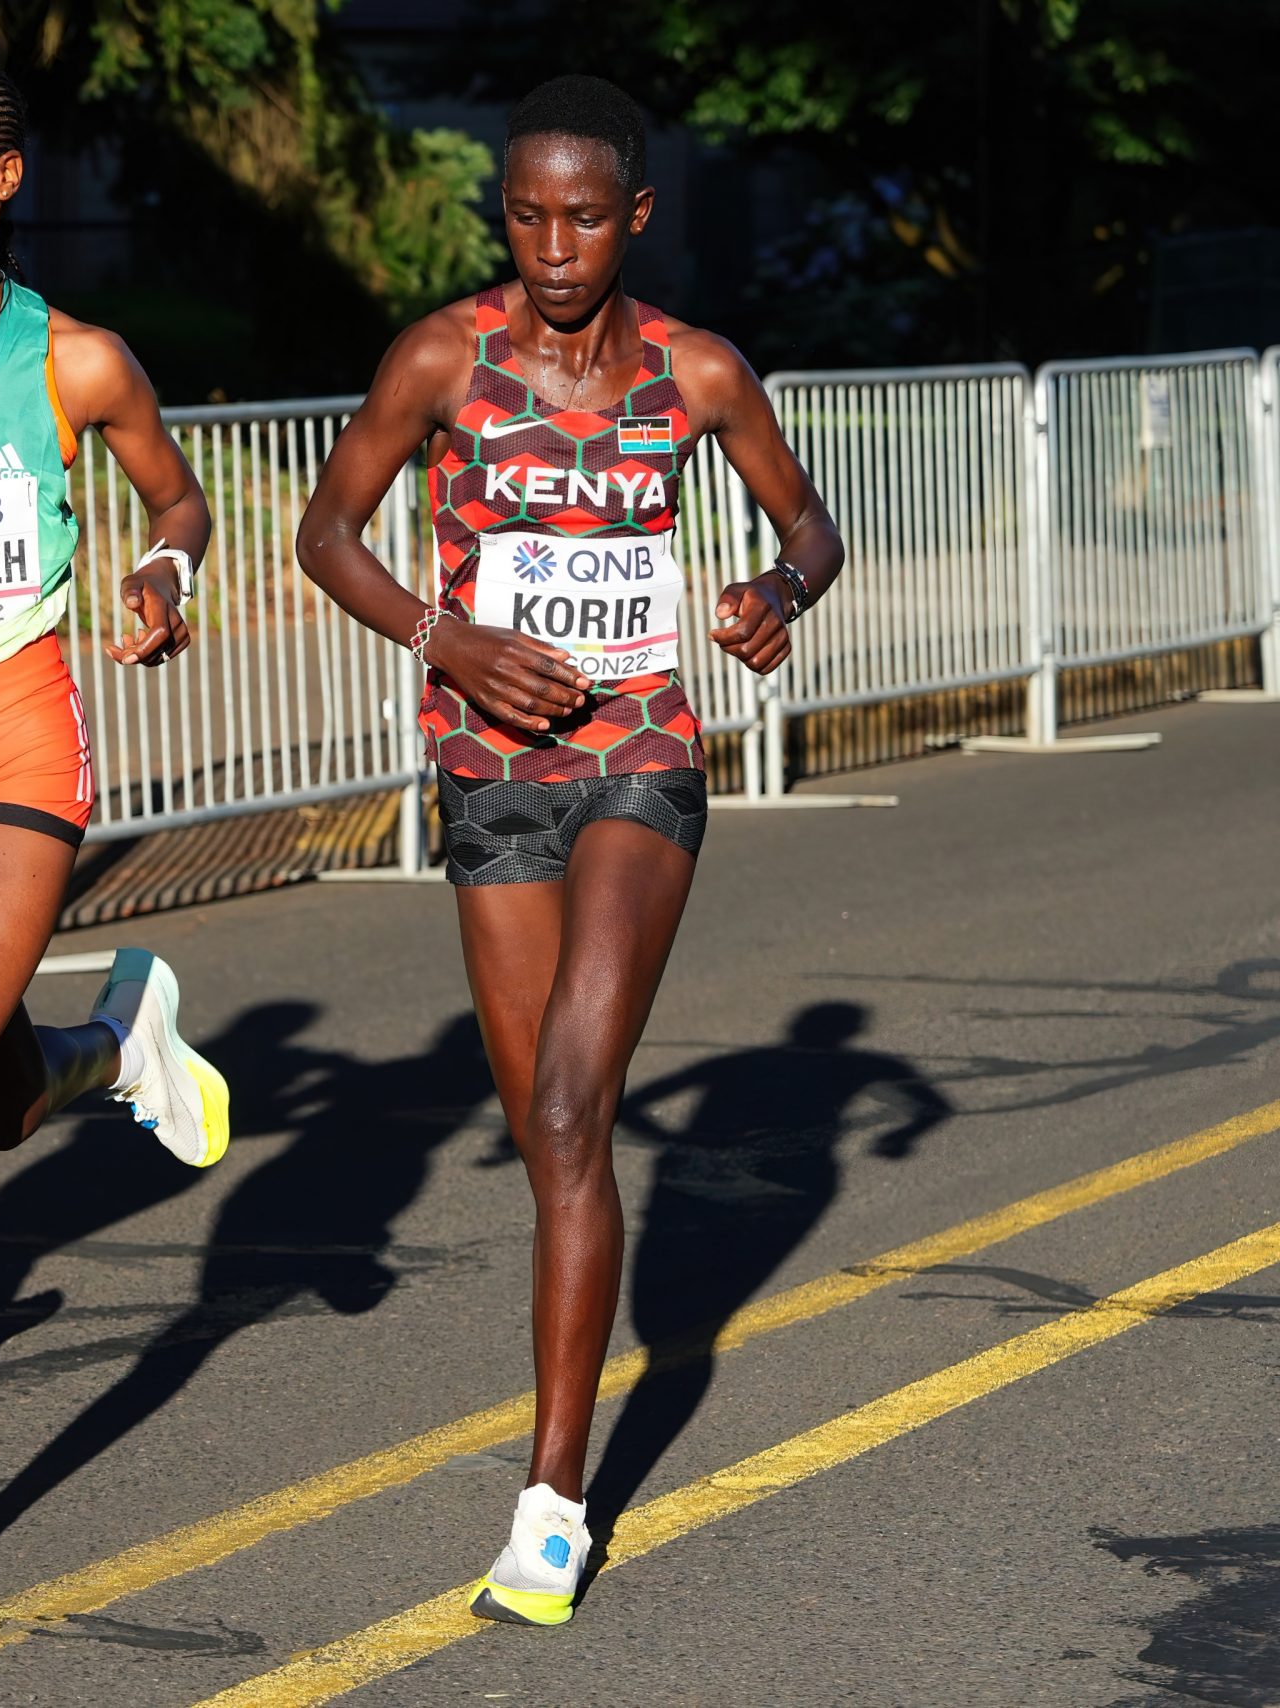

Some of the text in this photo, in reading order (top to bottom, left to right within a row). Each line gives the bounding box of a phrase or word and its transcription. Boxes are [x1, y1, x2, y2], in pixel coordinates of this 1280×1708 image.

[485, 464, 666, 509] KENYA
[567, 546, 654, 583] QNB
[512, 592, 651, 640] KORIR
